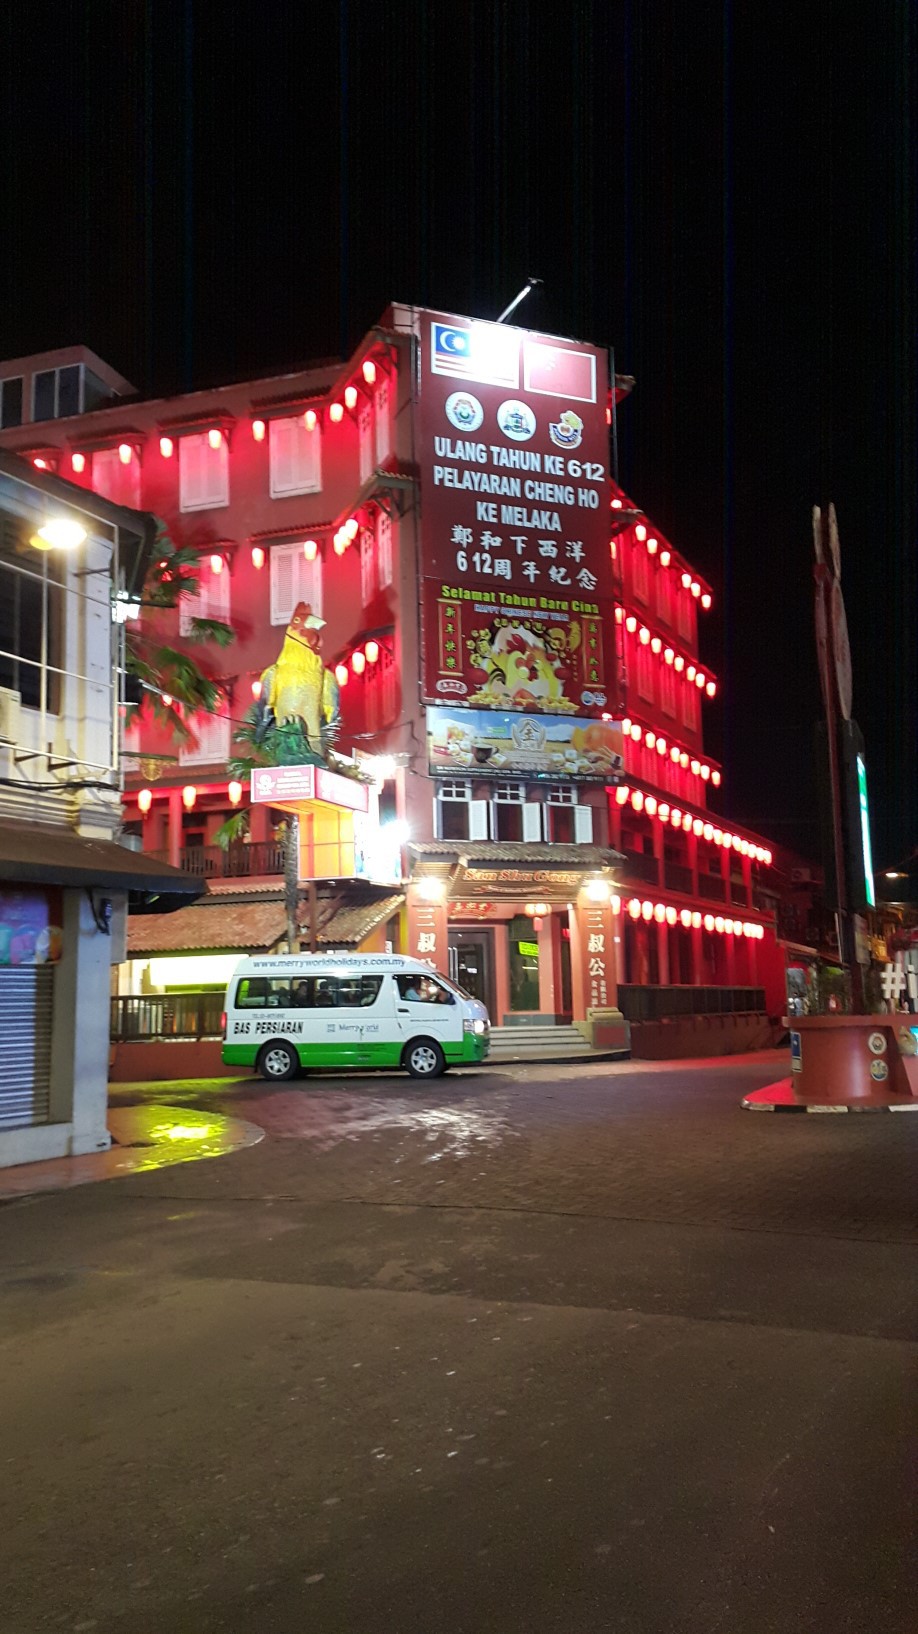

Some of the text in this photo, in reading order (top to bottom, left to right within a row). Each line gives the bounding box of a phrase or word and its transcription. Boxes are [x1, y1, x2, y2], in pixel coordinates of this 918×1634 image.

[434, 436, 605, 482] ULANG TAHUN KE 612
[433, 465, 599, 509] PELAYARAN CHENG HO
[476, 501, 562, 532] KE MELAKA
[441, 585, 599, 614] Selamat Tahun Baru Cina
[463, 868, 581, 886] San Shu Gong
[587, 910, 605, 977] 三叔公
[253, 957, 406, 969] www.merryworldholidays.com.my
[233, 1021, 304, 1035] BAS PERSIARAN
